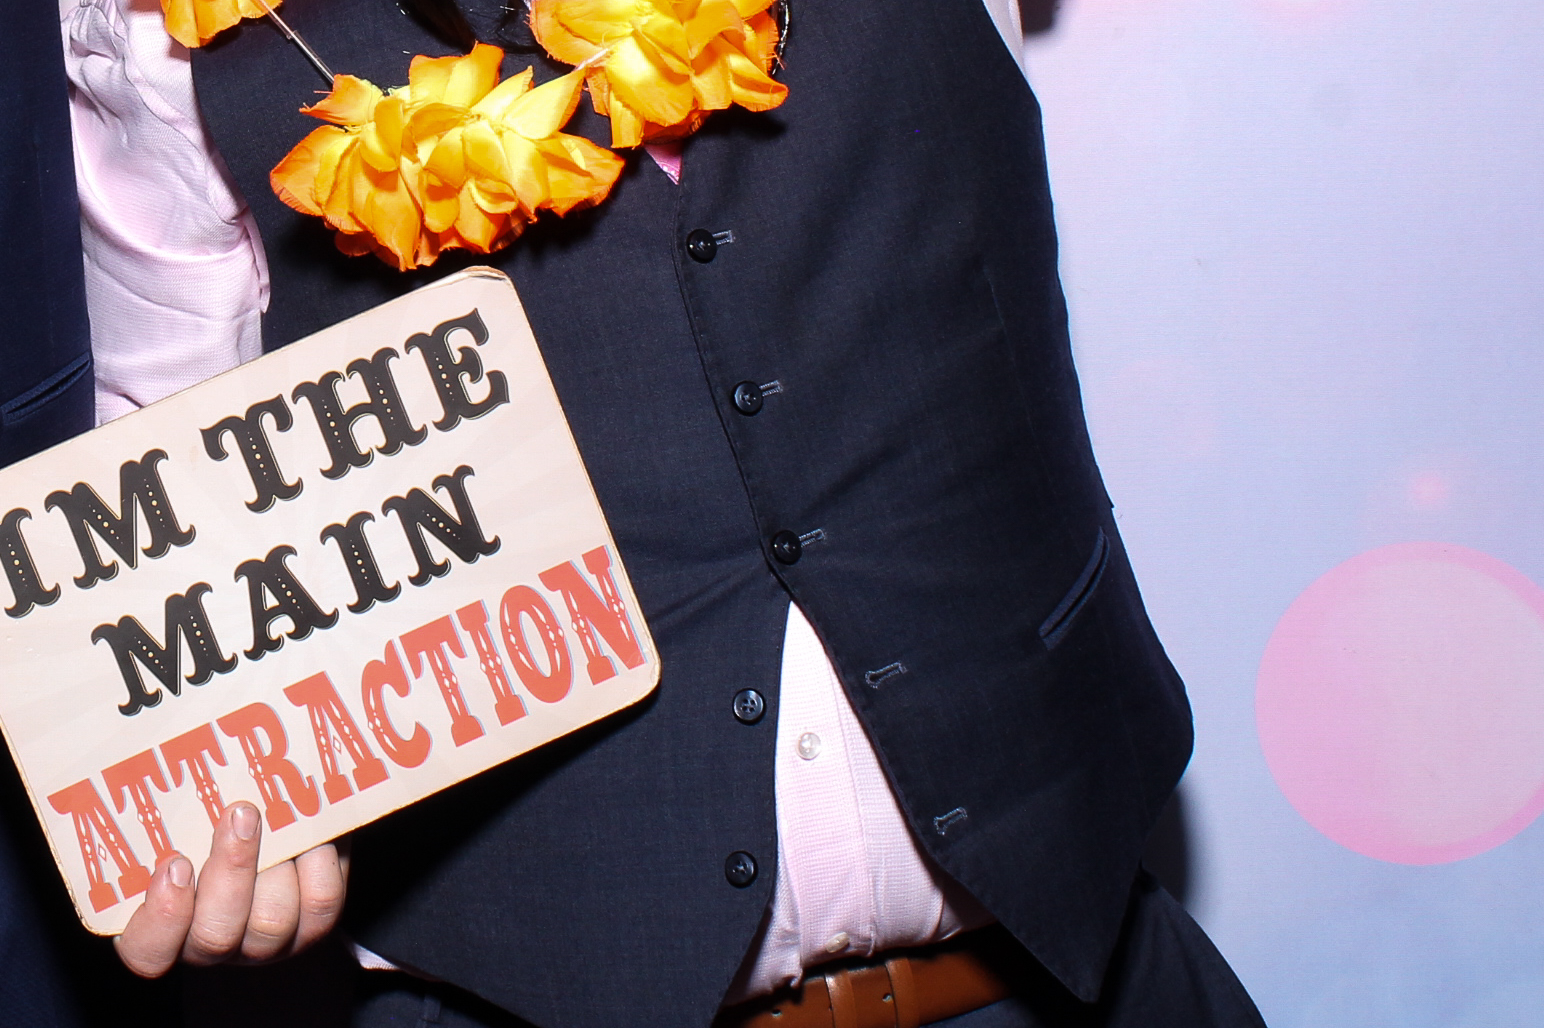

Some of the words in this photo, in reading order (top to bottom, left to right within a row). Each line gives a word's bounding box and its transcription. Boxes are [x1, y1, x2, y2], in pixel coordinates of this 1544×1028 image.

[200, 308, 511, 514] THE
[91, 464, 501, 717] MAIN
[47, 545, 649, 914] ATTRACTION
